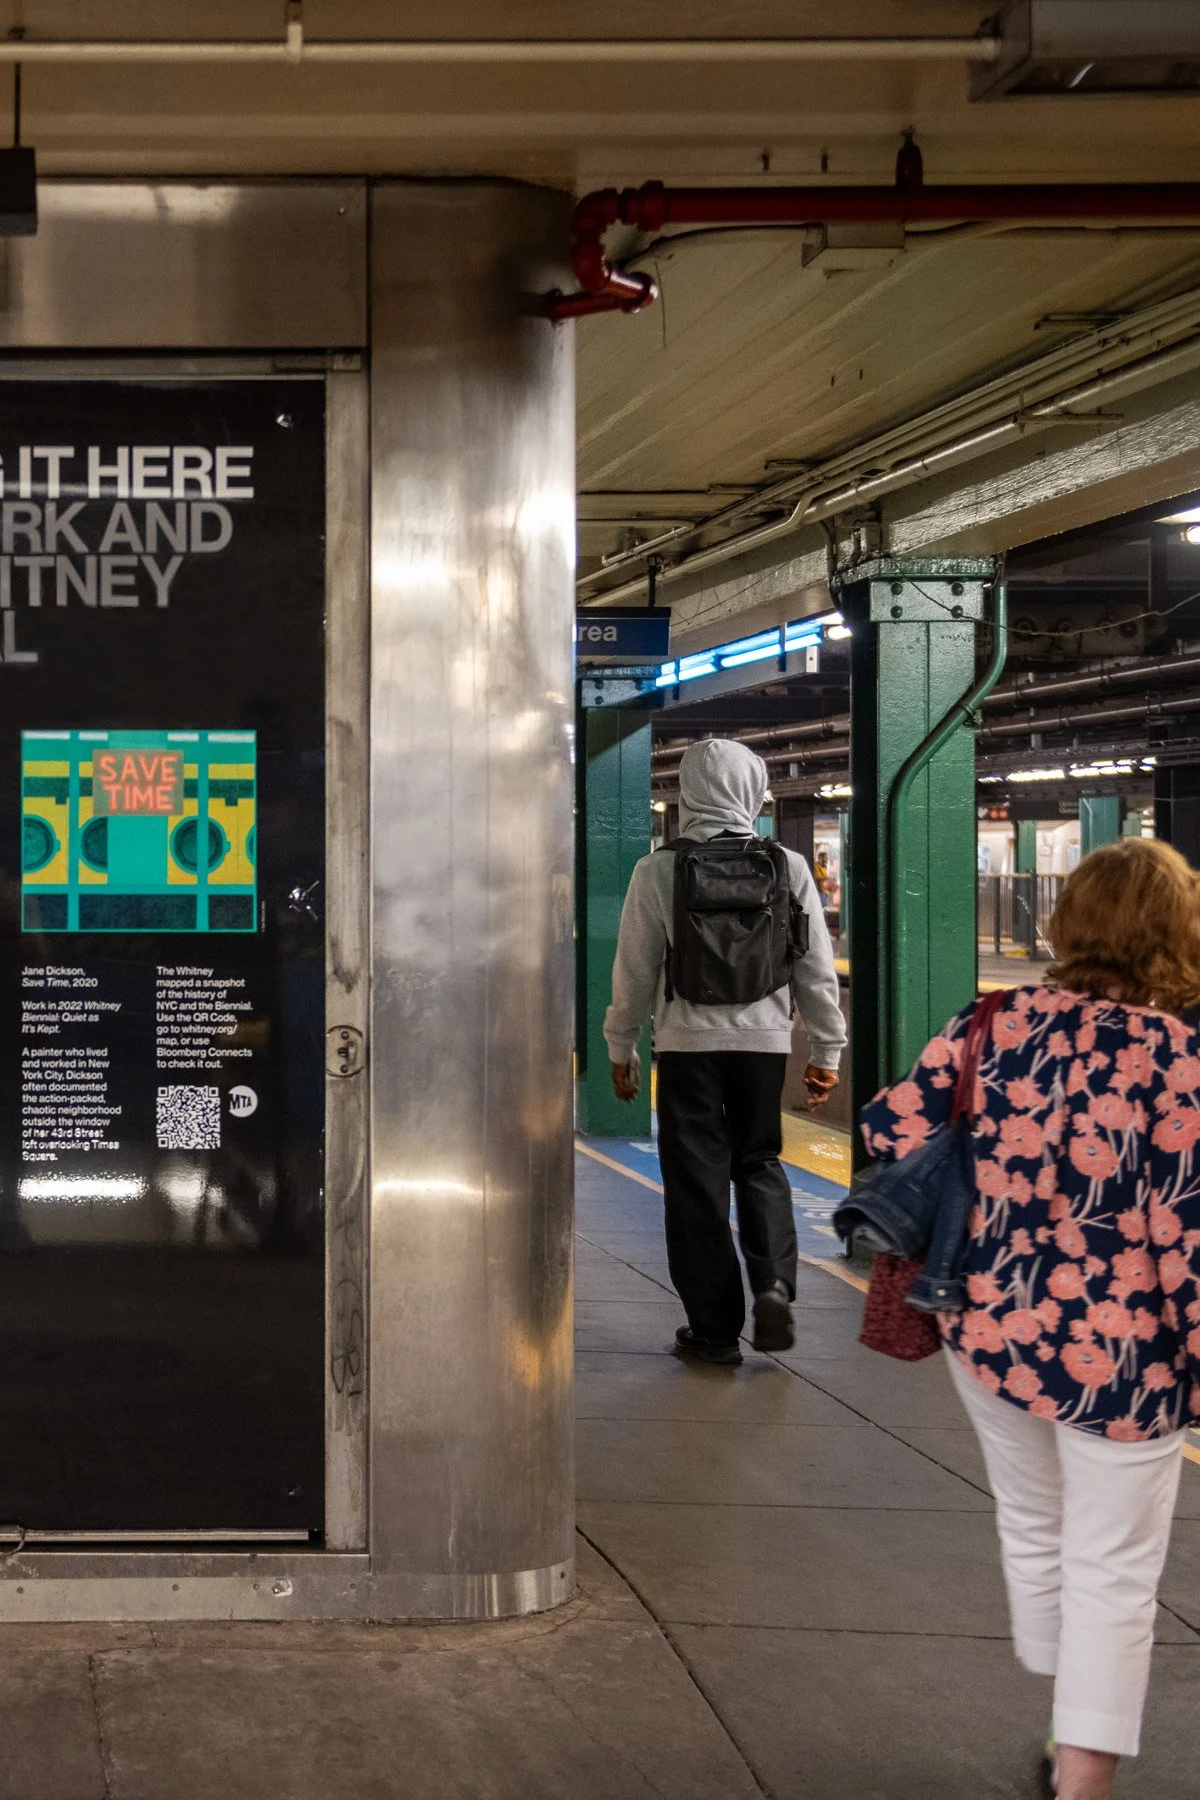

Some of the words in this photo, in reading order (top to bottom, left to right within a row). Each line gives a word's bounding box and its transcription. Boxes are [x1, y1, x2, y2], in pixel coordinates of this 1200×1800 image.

[18, 445, 75, 499] IT
[87, 445, 255, 499] HERE
[99, 501, 234, 553] AND
[576, 624, 618, 642] rea
[98, 752, 177, 784] SAVE
[102, 783, 174, 813] TIME
[22, 966, 44, 975] Jane
[157, 966, 175, 975] The
[176, 966, 214, 977] Whitney
[22, 978, 45, 987] Save
[73, 978, 98, 987] 2020
[156, 978, 194, 988] mapped
[203, 978, 245, 988] snapshot
[156, 990, 166, 998] of
[168, 990, 183, 998] the
[184, 990, 216, 1000] history
[217, 990, 227, 998] of
[22, 1001, 46, 1010] Work
[48, 1001, 56, 1010] in
[58, 1001, 83, 1010] 2022
[84, 1001, 121, 1012] Whitney
[156, 1001, 178, 1010] NYC
[179, 1001, 197, 1010] and
[198, 1002, 213, 1010] the
[62, 1012, 87, 1022] Quiet
[156, 1013, 175, 1022] Use
[176, 1013, 192, 1022] the
[193, 1012, 209, 1022] QR
[156, 1026, 169, 1035] go
[170, 1025, 180, 1033] to
[22, 1047, 29, 1056] A
[31, 1047, 63, 1058] painter
[65, 1048, 85, 1056] who
[86, 1048, 108, 1056] lived
[157, 1047, 207, 1058] Bloomberg
[208, 1047, 252, 1057] Connects
[22, 1059, 40, 1068] and
[42, 1059, 76, 1068] worked
[78, 1059, 87, 1067] in
[88, 1059, 110, 1068] New
[157, 1060, 167, 1068] to
[168, 1059, 196, 1068] check
[197, 1059, 203, 1068] it
[22, 1070, 43, 1079] York
[66, 1070, 103, 1080] Dickson
[22, 1082, 47, 1091] often
[48, 1082, 107, 1091] documented
[22, 1094, 37, 1103] the
[230, 1093, 252, 1110] MTA
[22, 1105, 56, 1114] chaotic
[58, 1105, 122, 1116] neighborhood
[22, 1117, 56, 1126] outside
[58, 1117, 73, 1126] the
[75, 1117, 110, 1126] window
[22, 1128, 32, 1137] of
[34, 1129, 49, 1137] her
[51, 1128, 73, 1137] 43rd
[74, 1128, 103, 1137] Street
[22, 1139, 38, 1149] loft
[39, 1140, 90, 1151] overlooking
[91, 1140, 119, 1149] Times
